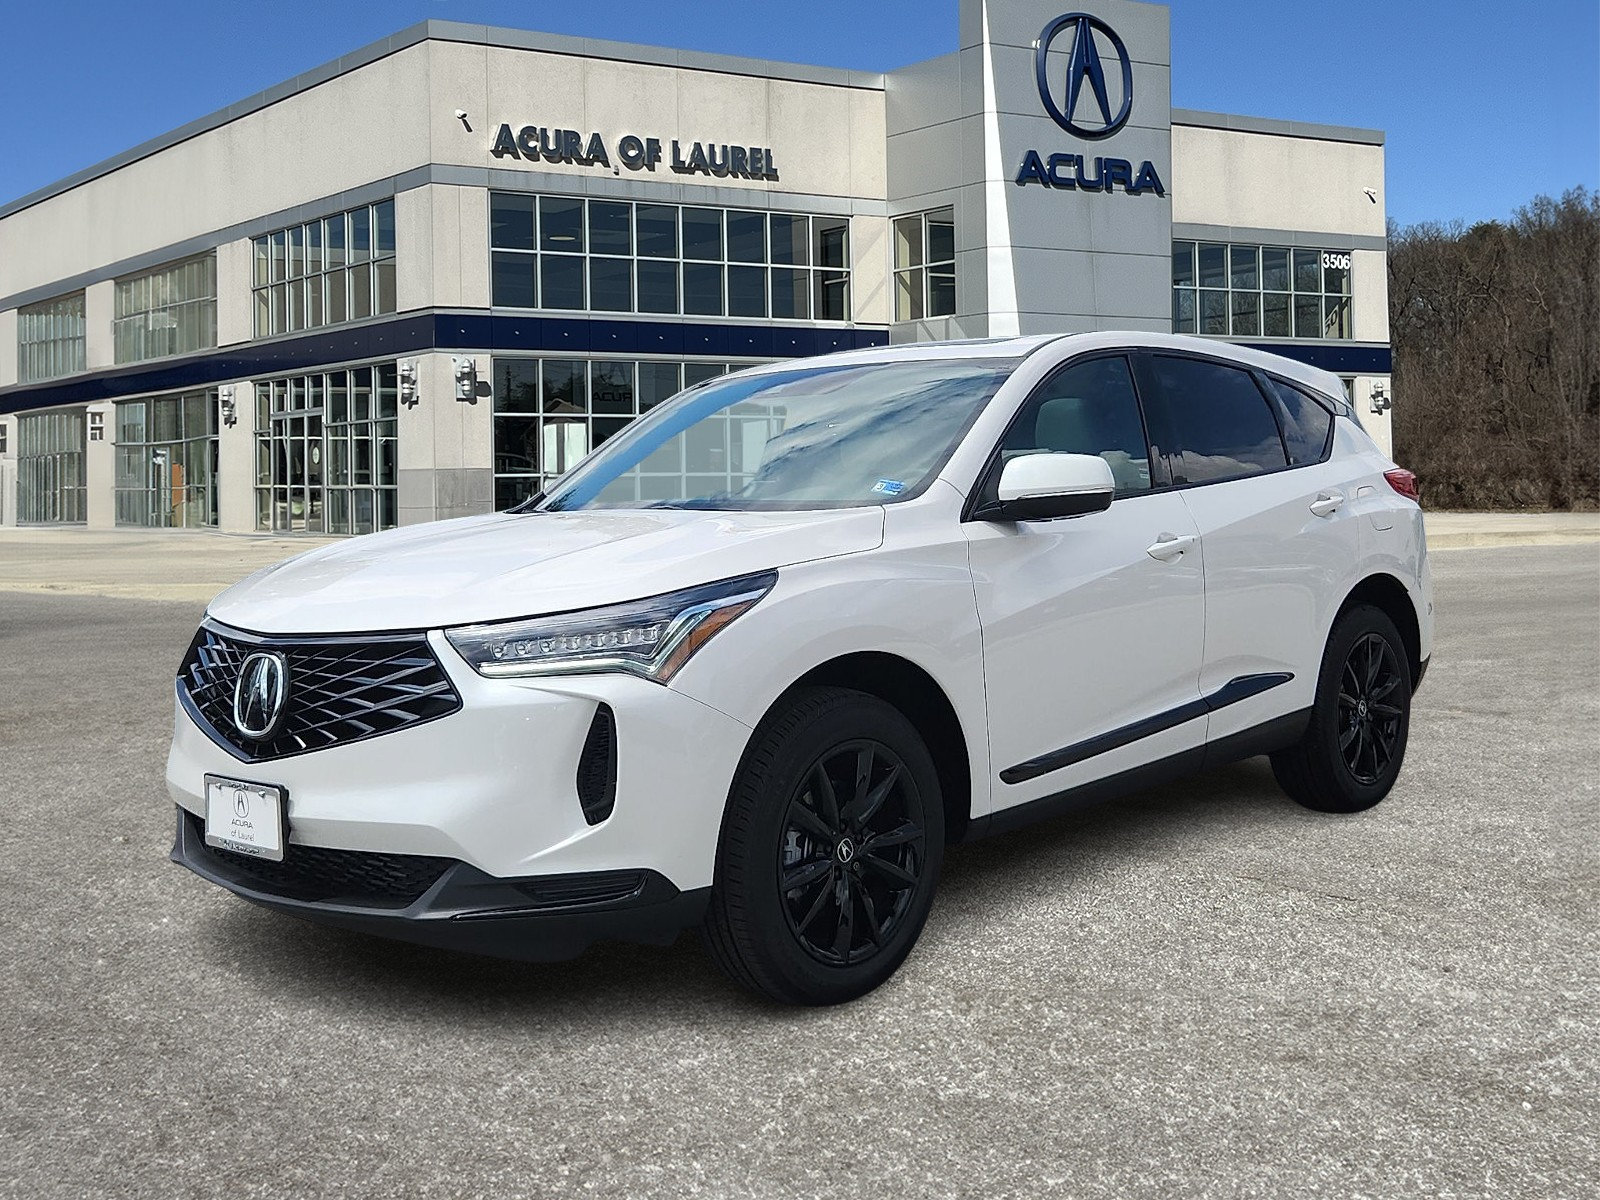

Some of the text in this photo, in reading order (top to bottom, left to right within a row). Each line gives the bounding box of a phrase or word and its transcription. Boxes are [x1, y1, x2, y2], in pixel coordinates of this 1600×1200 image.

[490, 123, 779, 181] ACURA OF LAUREL
[1015, 149, 1166, 198] ACURA
[1322, 253, 1351, 270] 3506
[231, 818, 254, 829] ACURA
